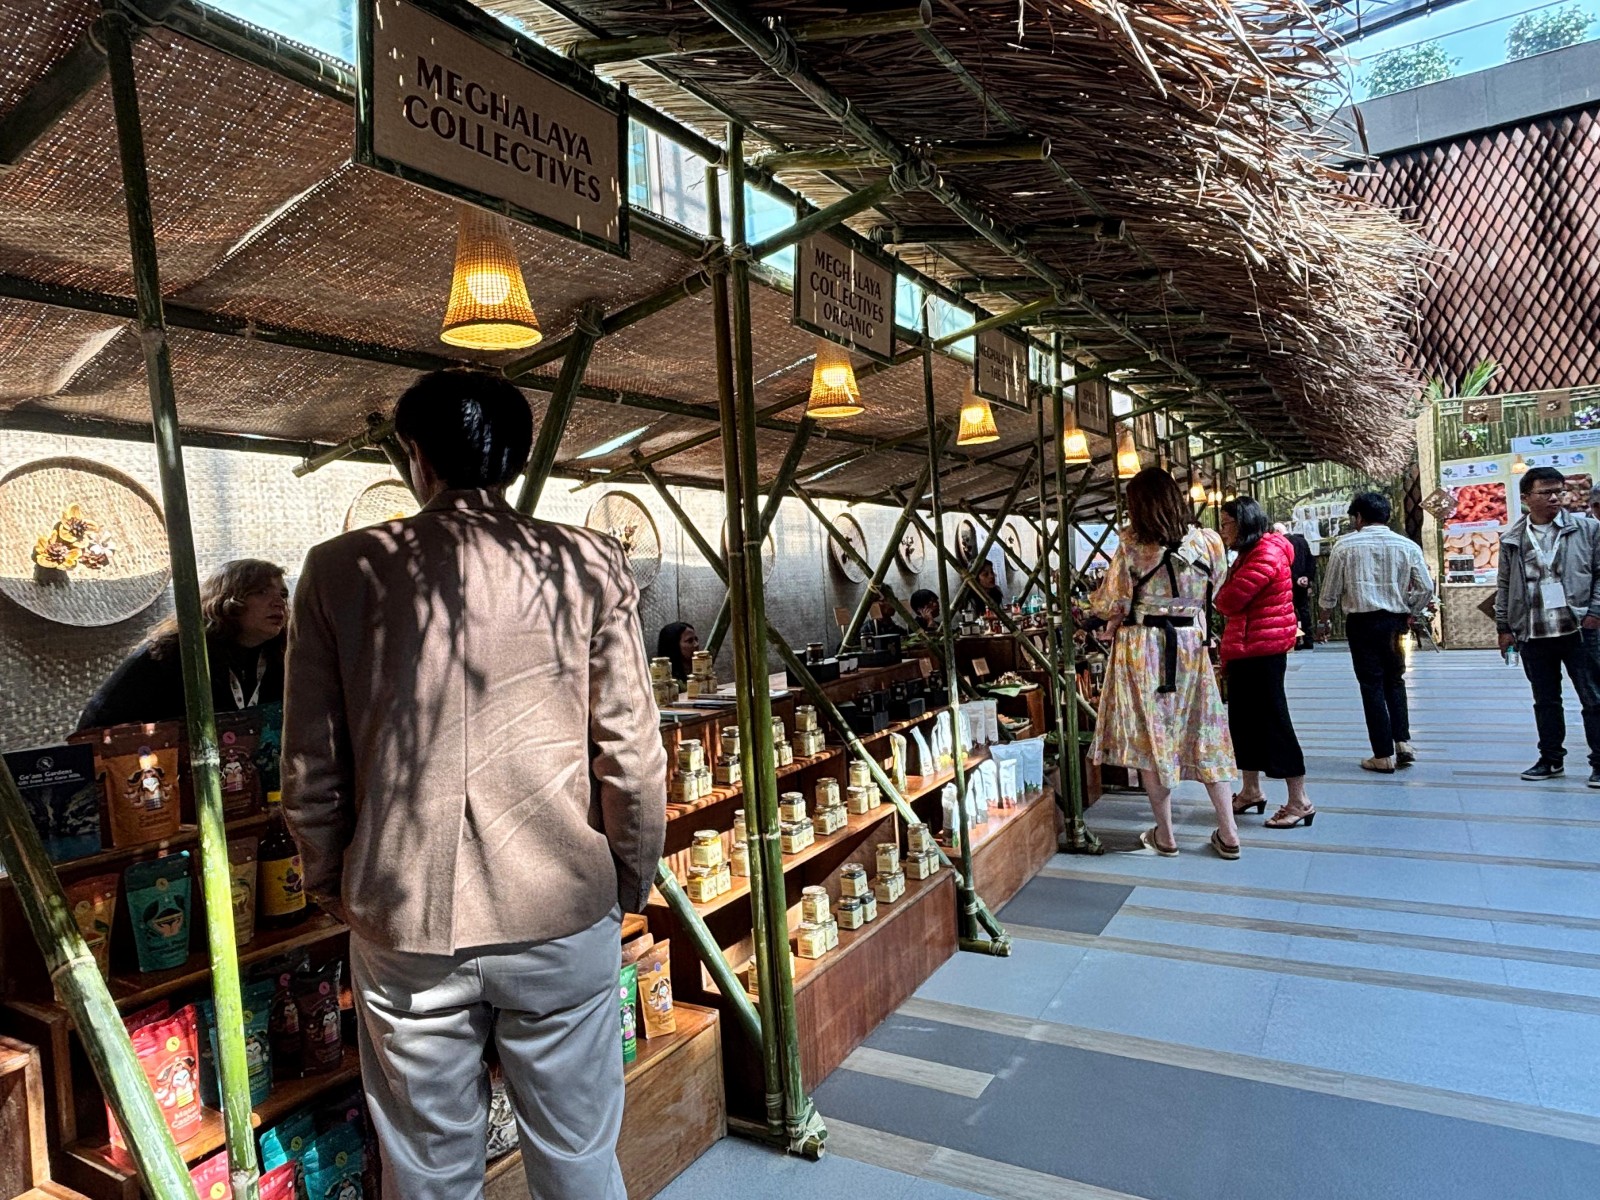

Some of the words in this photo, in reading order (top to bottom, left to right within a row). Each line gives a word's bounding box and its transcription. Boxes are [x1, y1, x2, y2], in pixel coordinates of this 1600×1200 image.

[417, 55, 592, 165] MEGHALAYA
[403, 95, 601, 202] COLLECTIVES
[810, 271, 884, 325] COLLECTIVES
[815, 248, 882, 300] MEGHALAYA
[823, 302, 874, 339] ORGANIC
[44, 769, 73, 778] Gardens
